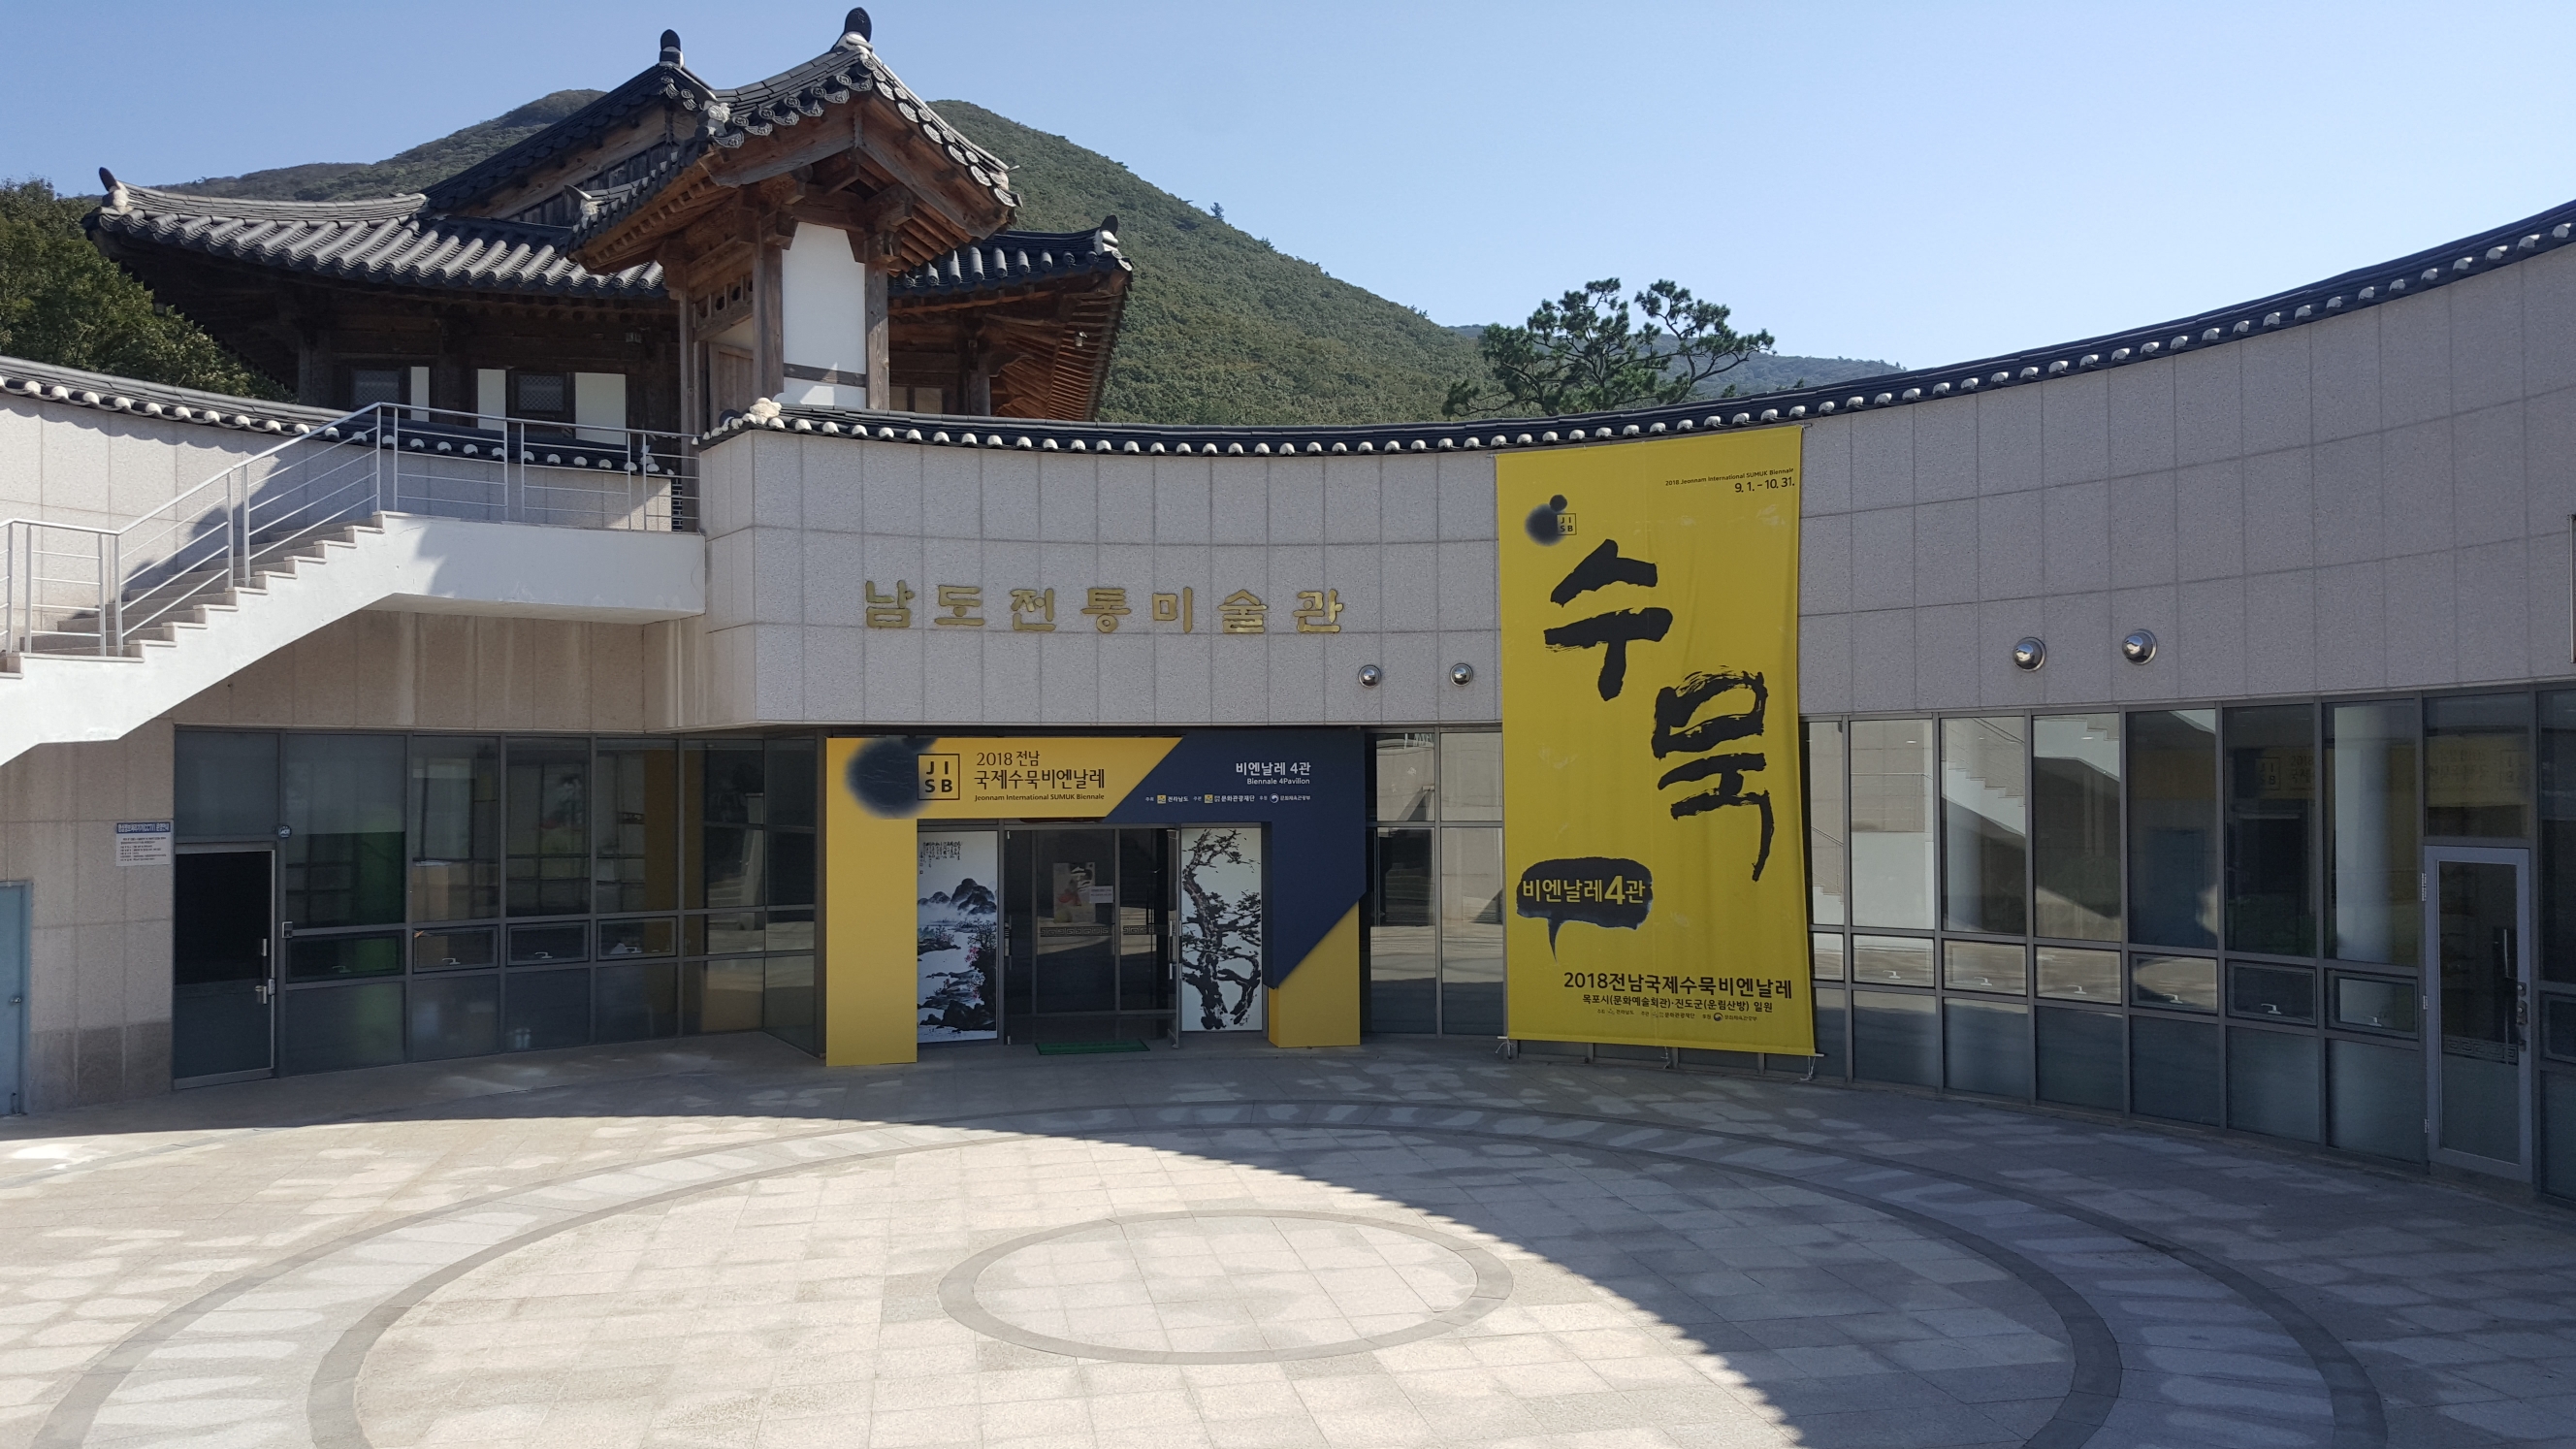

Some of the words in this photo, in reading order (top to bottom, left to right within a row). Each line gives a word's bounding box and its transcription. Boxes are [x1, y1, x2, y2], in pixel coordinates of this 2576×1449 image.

[1708, 473, 1746, 482] International
[1746, 469, 1768, 479] SUMUK
[865, 579, 1344, 633] 남도전통미술관
[976, 752, 1013, 766] 2018
[1015, 750, 1041, 767] 전남
[974, 768, 1105, 789] 국제수묵비엔날레
[1235, 761, 1287, 777] 비엔날레
[1290, 761, 1311, 777] 4관
[1522, 876, 1646, 905] 비엔날레4관
[1563, 972, 1792, 999] 2018전남국제수묵비엔날레
[1754, 1002, 1773, 1014] 일원
